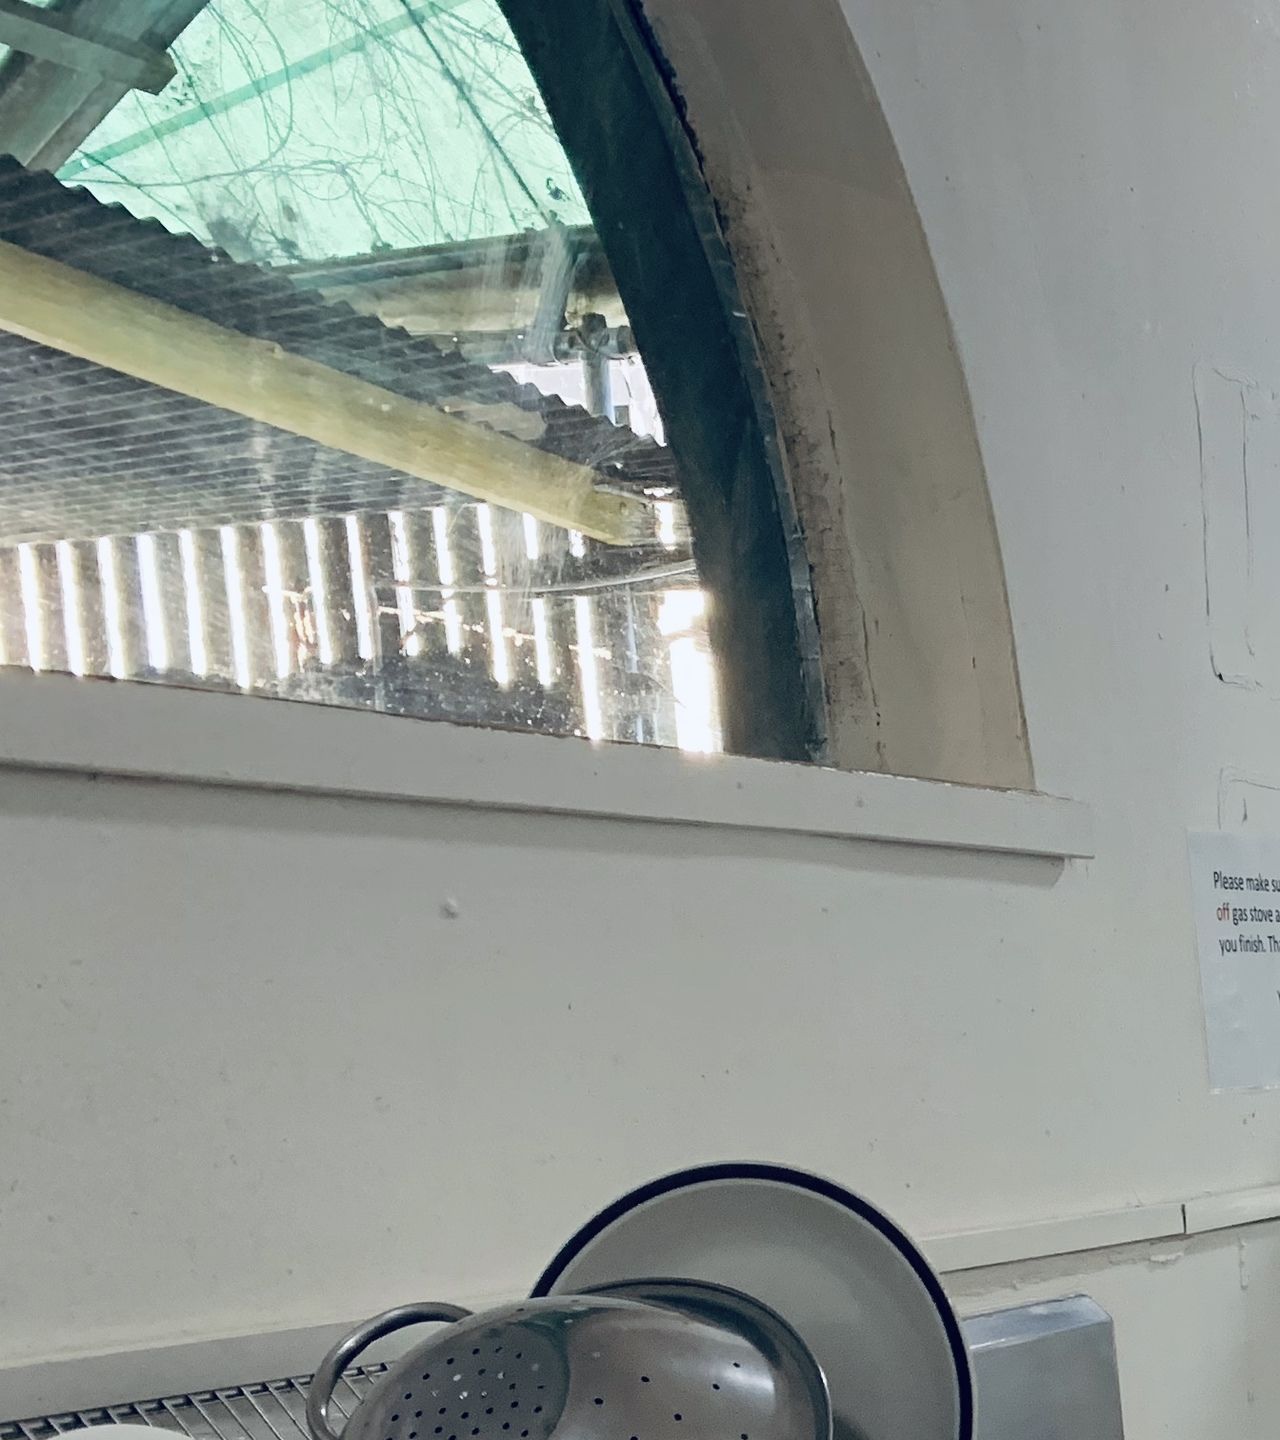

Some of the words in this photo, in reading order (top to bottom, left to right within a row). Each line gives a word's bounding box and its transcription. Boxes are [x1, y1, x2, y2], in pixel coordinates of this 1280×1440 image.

[1213, 871, 1244, 891] Please
[1246, 873, 1269, 892] make
[1217, 902, 1230, 922] off
[1232, 907, 1248, 926] gas
[1250, 906, 1273, 923] stove
[1219, 939, 1237, 956] you
[1238, 934, 1266, 953] finish.
